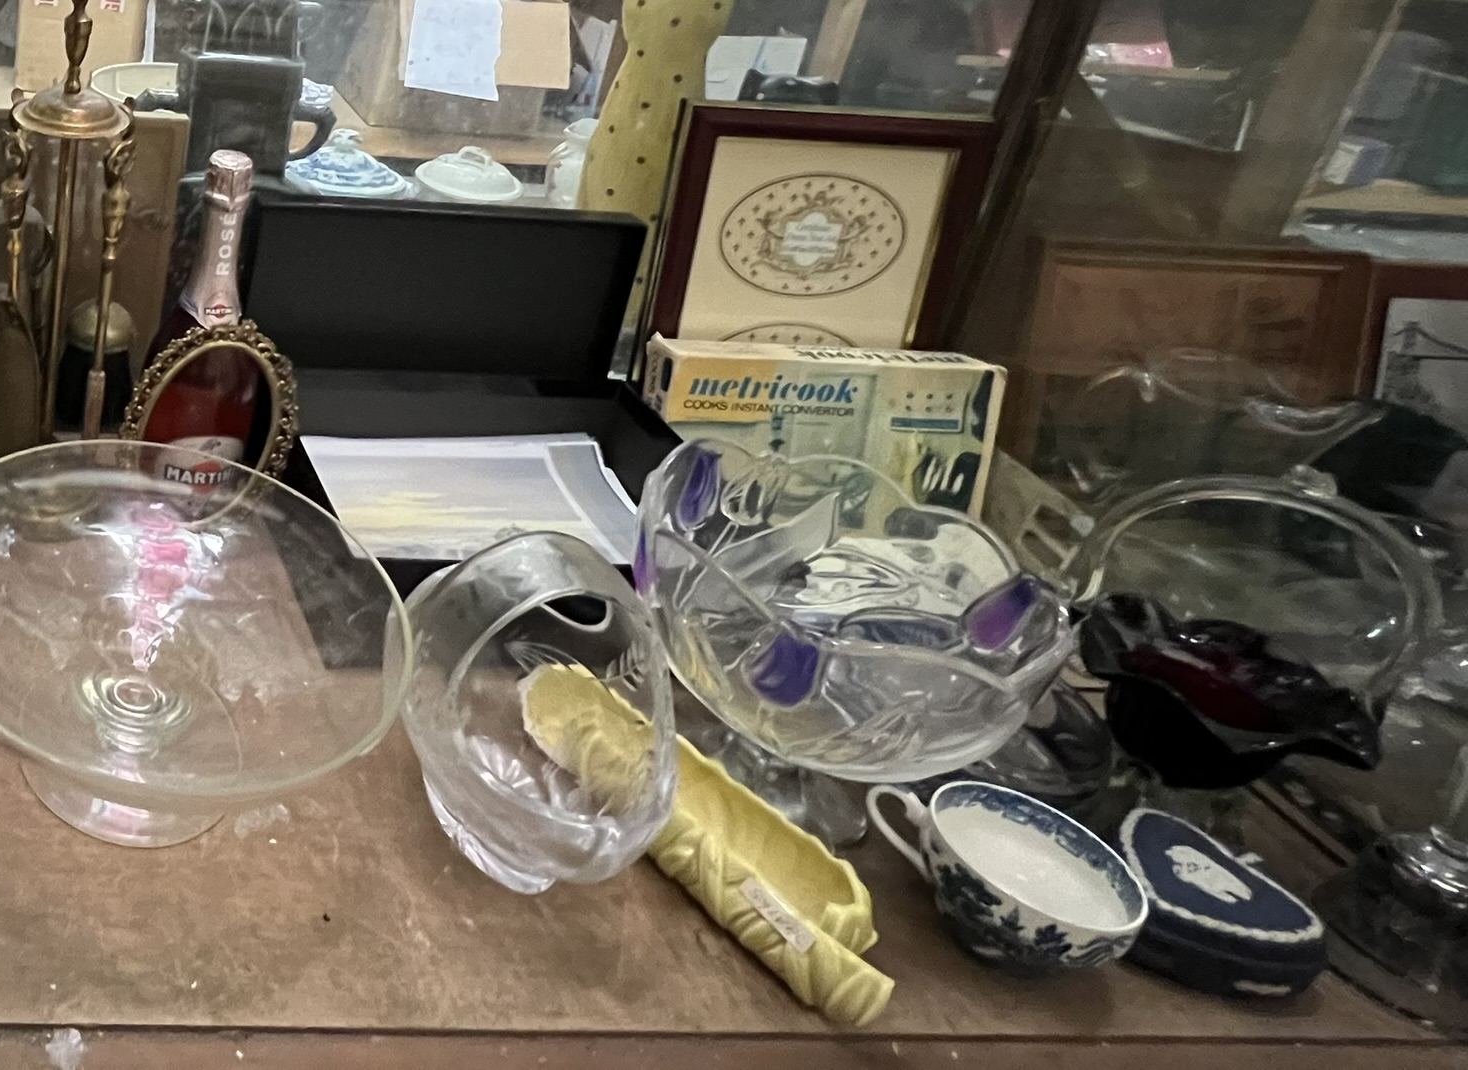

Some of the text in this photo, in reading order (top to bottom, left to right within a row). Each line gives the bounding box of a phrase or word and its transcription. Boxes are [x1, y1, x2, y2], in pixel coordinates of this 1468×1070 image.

[215, 211, 237, 276] ROSÉ
[688, 374, 859, 404] metricook
[730, 401, 781, 415] INSTANT
[783, 403, 855, 417] CONVERTOR
